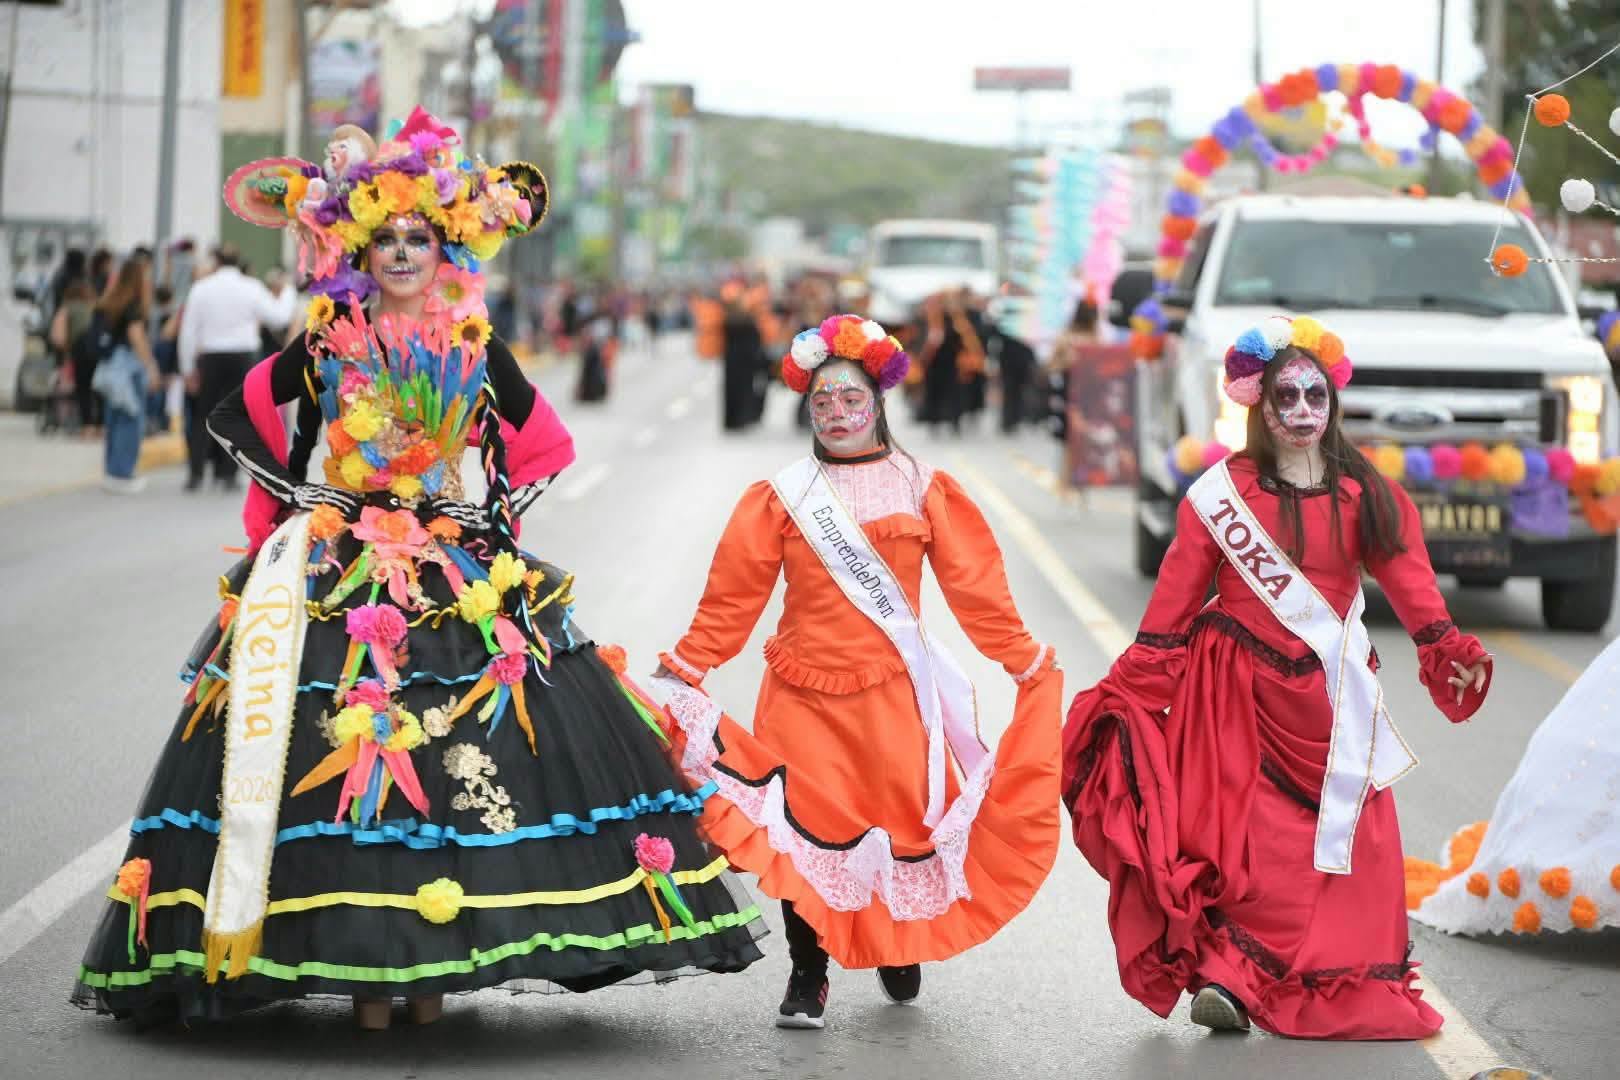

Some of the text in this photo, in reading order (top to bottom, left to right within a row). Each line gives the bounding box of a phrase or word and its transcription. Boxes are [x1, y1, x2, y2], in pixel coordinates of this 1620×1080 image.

[812, 505, 894, 619] EmprendeDown
[1209, 499, 1292, 600] TOKA
[239, 584, 292, 741] Reina
